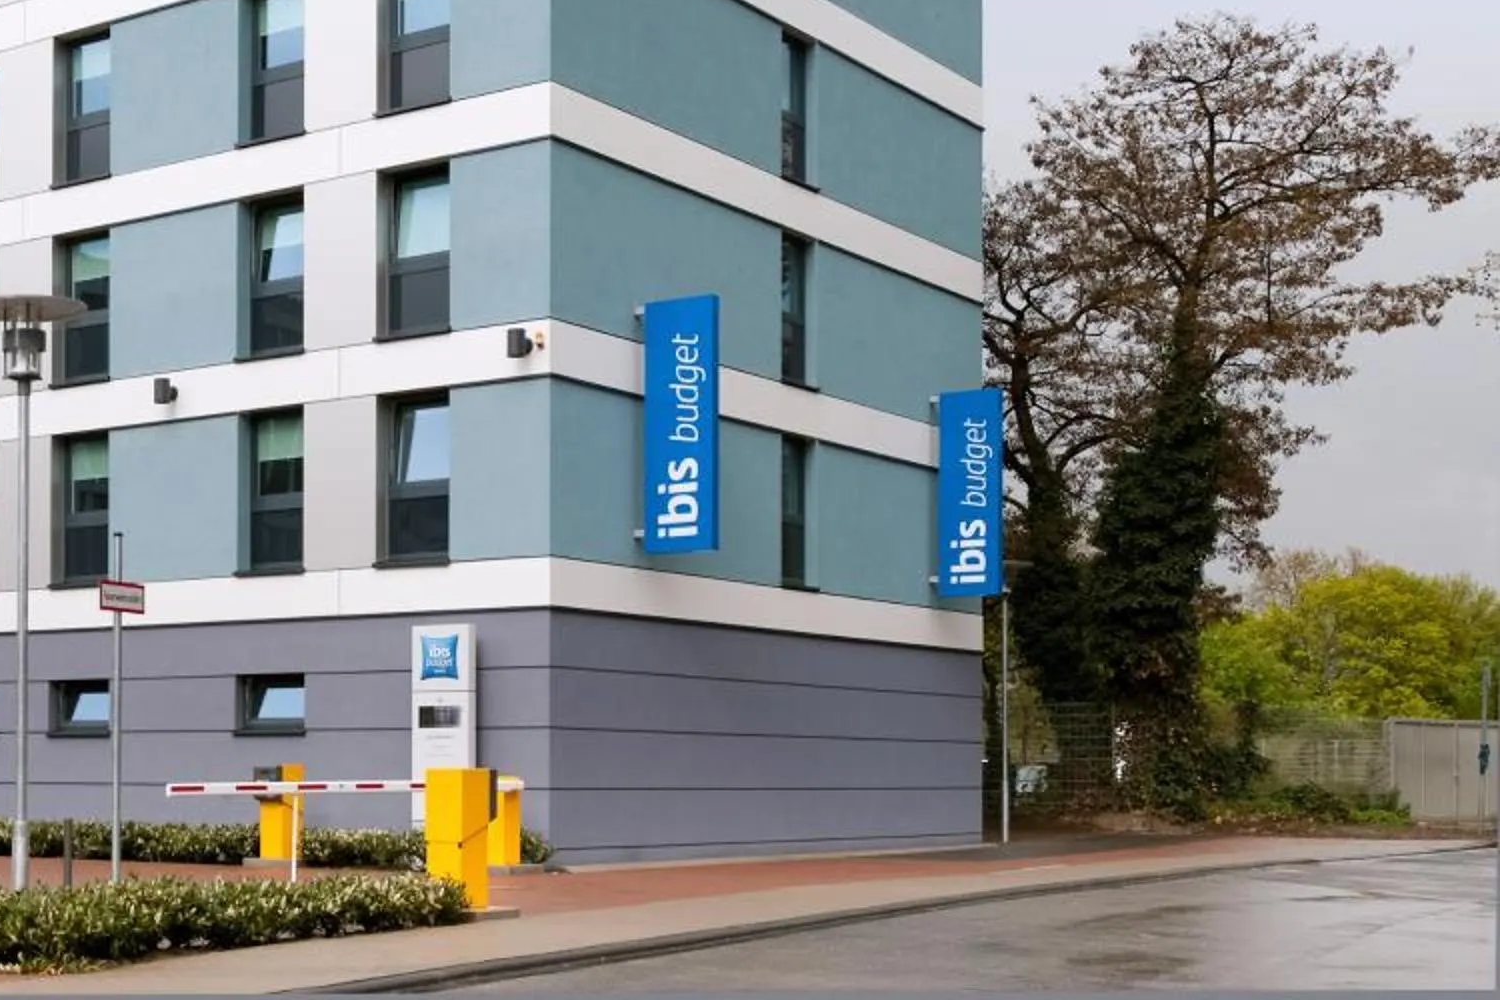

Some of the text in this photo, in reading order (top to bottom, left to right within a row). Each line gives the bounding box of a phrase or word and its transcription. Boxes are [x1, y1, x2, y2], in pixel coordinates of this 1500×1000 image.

[657, 332, 707, 539] ibis budget
[950, 417, 993, 585] ibis budget
